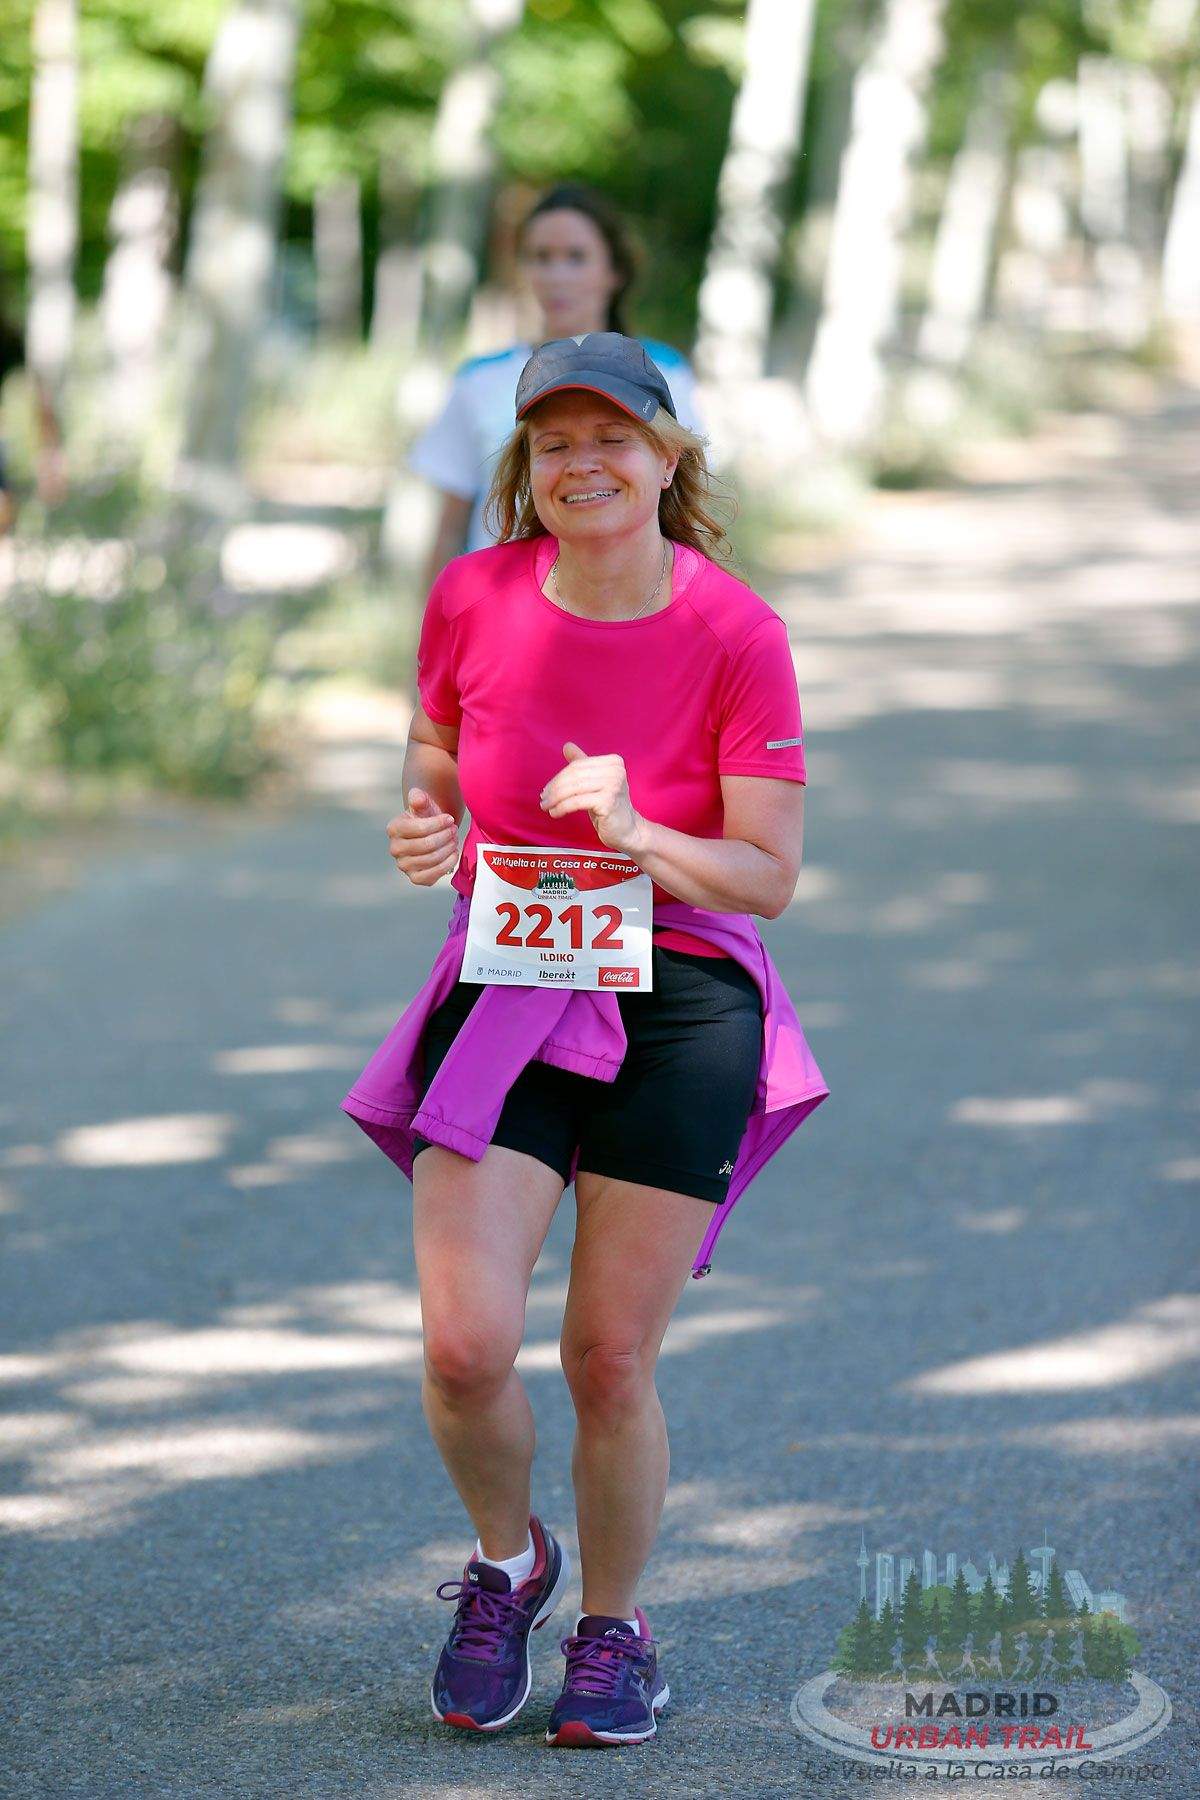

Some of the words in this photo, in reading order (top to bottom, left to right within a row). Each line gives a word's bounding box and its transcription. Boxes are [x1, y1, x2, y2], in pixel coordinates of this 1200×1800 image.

[537, 859, 548, 868] la
[553, 860, 581, 869] Casa
[583, 860, 598, 869] de
[600, 861, 639, 873] Campo
[495, 902, 624, 950] 2212
[540, 952, 575, 963] ILDIKO
[487, 968, 522, 978] MADRID
[538, 970, 576, 980] Iberext
